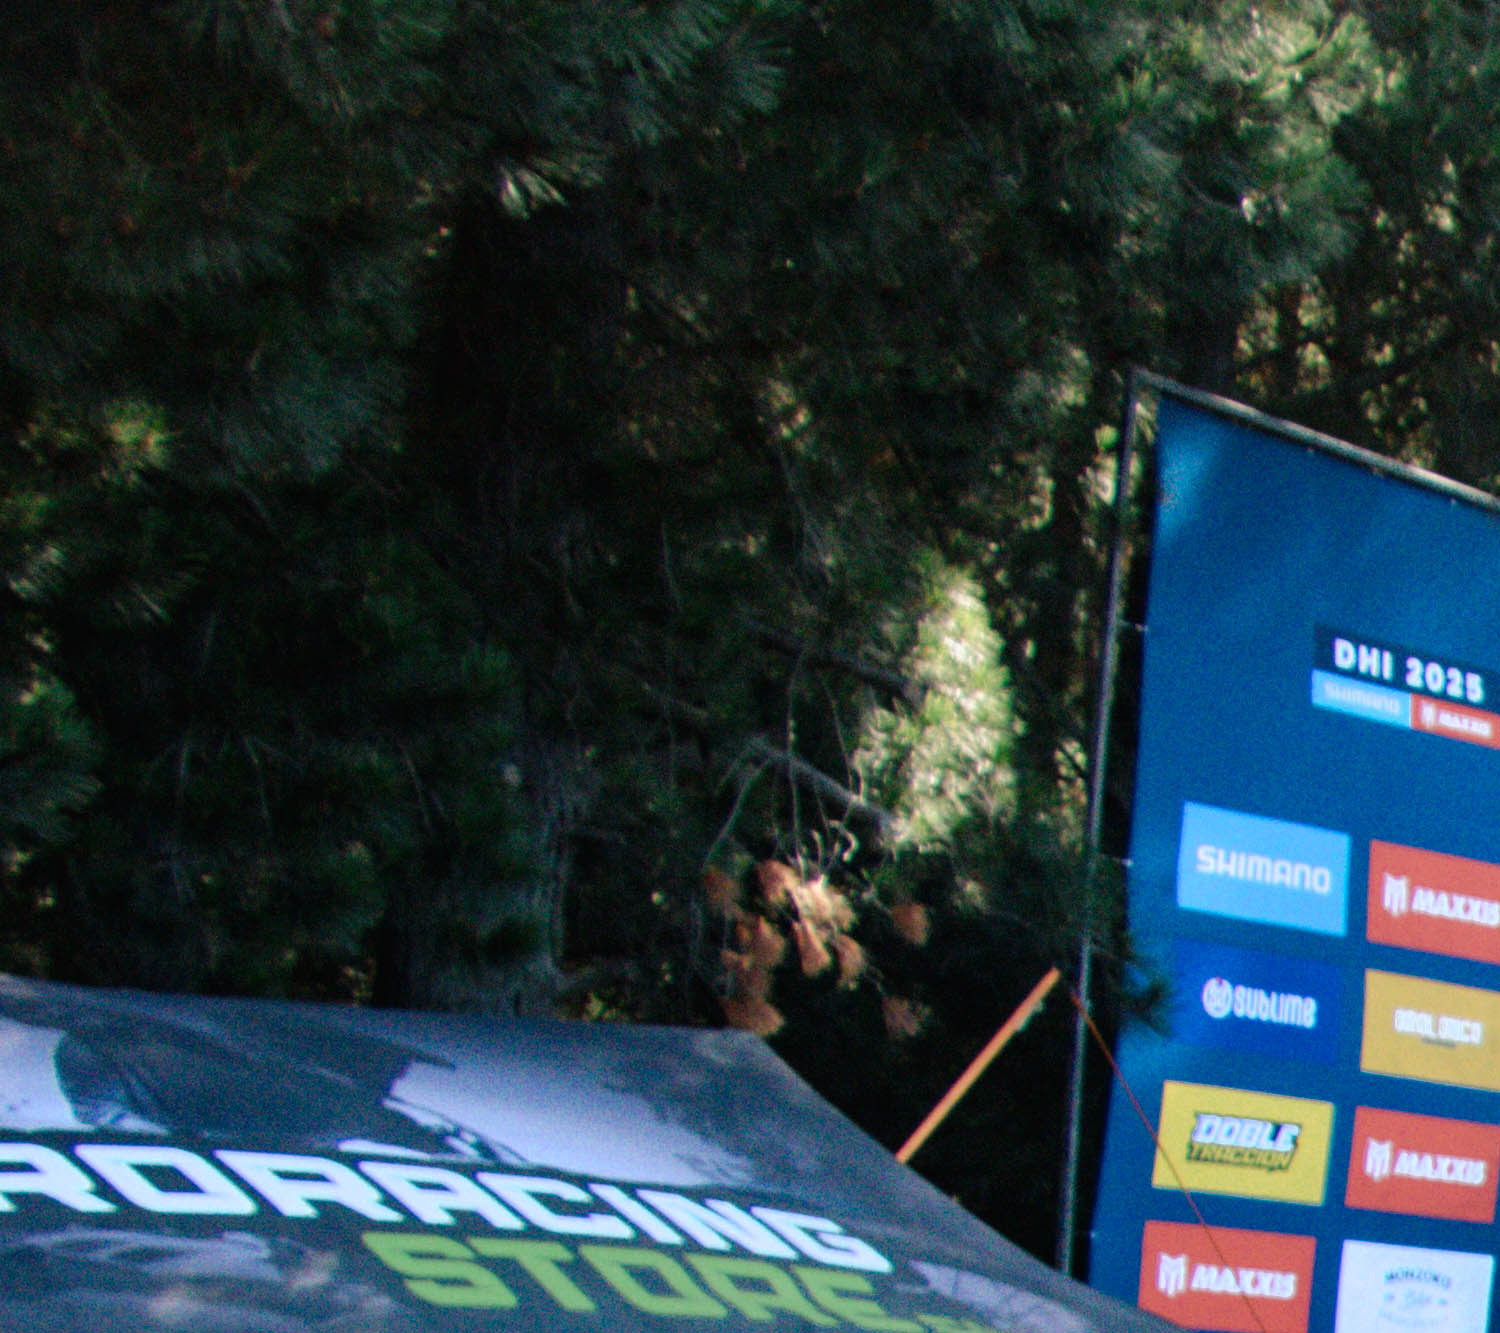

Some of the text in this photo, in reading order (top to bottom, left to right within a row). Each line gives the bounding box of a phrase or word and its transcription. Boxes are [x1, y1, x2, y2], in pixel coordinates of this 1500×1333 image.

[1334, 638, 1485, 703] DHI 2025
[1196, 845, 1331, 895] SHIMANO
[1394, 1149, 1487, 1188] MAXXIS
[1189, 1262, 1298, 1301] MAXXIS
